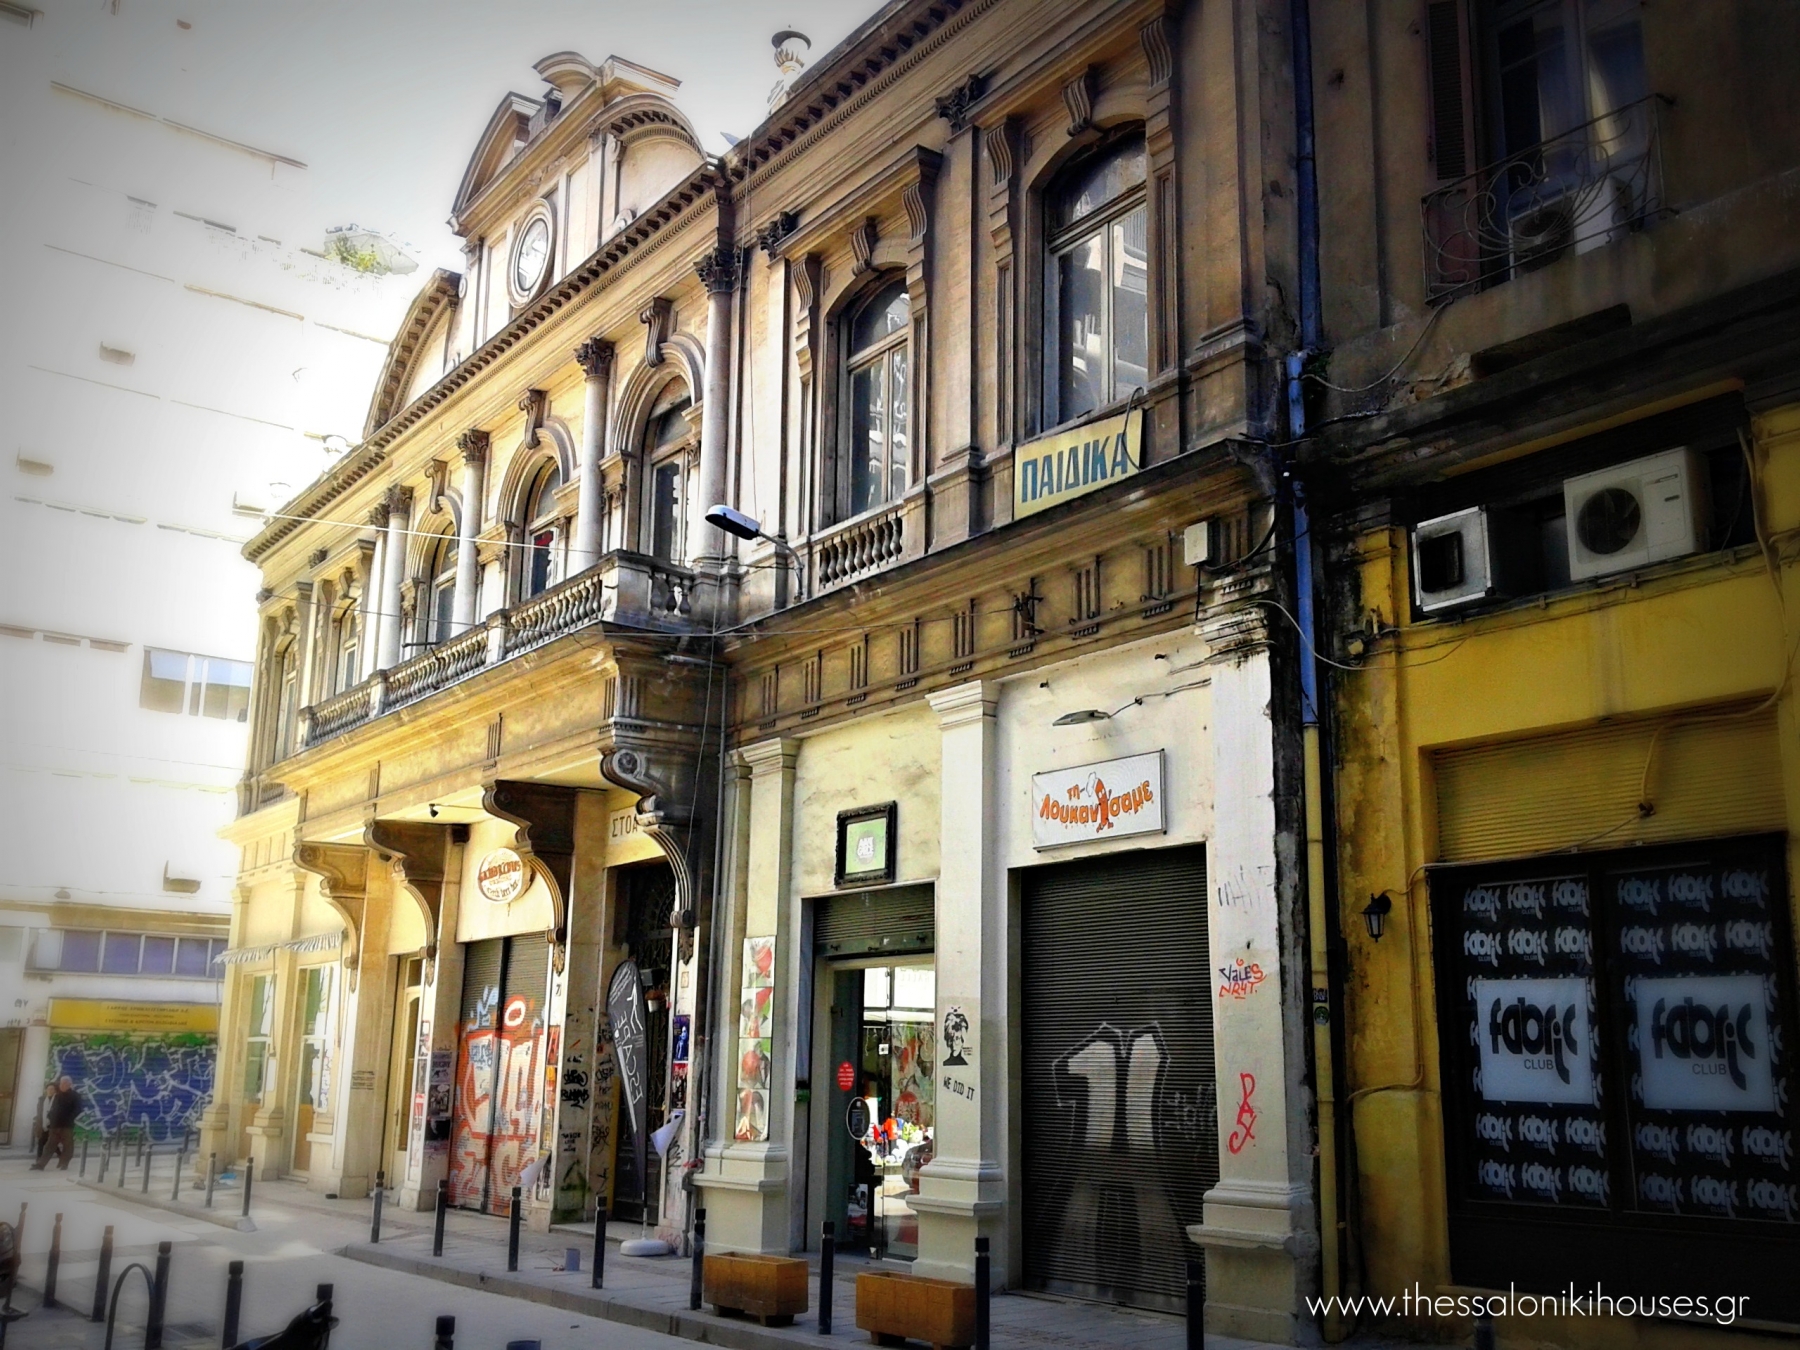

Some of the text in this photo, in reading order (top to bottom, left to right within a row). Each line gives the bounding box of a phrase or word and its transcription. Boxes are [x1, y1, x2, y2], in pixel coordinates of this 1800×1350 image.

[1021, 432, 1128, 504] ΠΑΙΔΙΚΑ
[1489, 997, 1578, 1085] fabric
[1523, 1058, 1555, 1071] CLUB
[1652, 996, 1756, 1092] fabric
[943, 1075, 975, 1101] WE DID IT
[1692, 1063, 1727, 1075] CLUB
